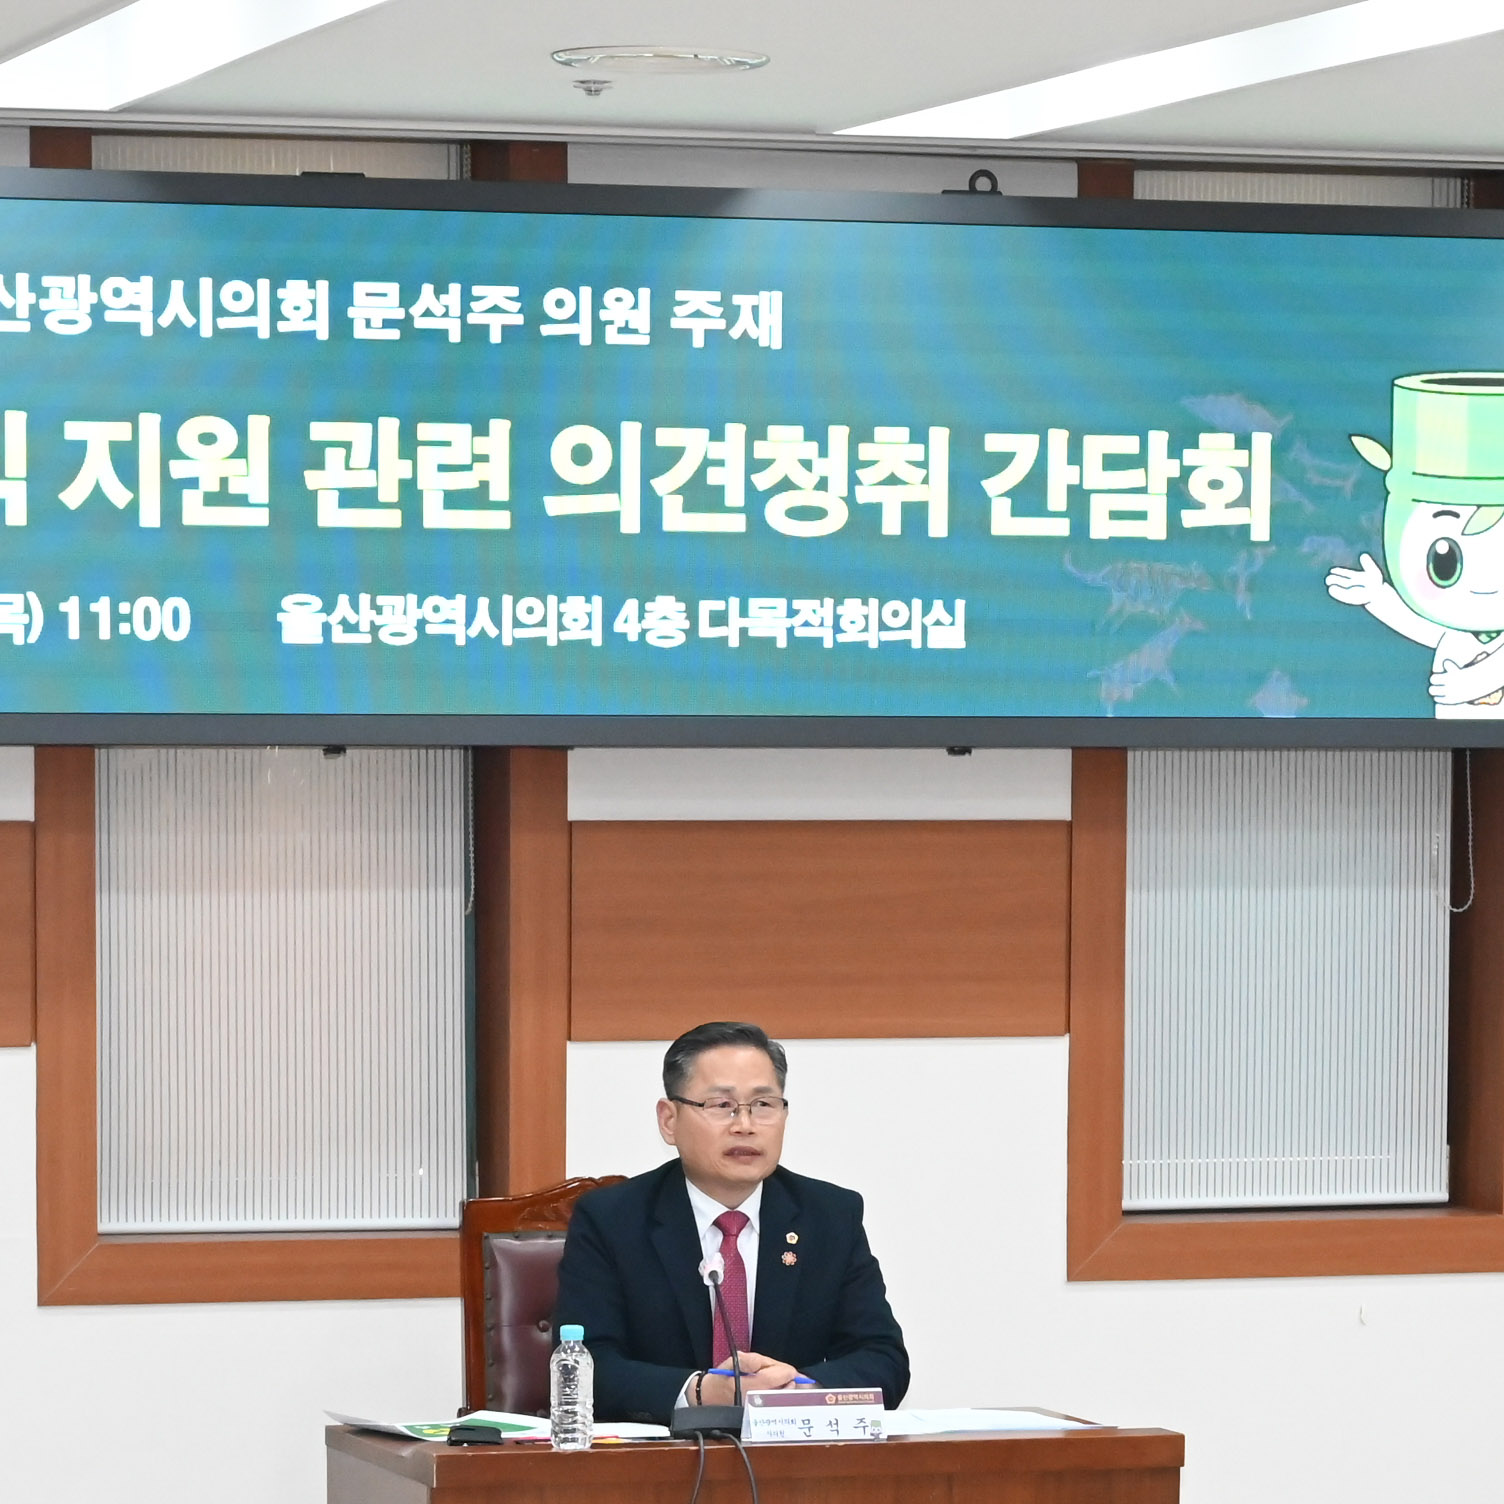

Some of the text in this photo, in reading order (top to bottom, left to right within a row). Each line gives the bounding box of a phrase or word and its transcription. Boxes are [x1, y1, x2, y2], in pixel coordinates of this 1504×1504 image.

[347, 281, 524, 344] 문석주
[539, 285, 651, 346] 의원
[670, 289, 783, 350] 주재
[58, 412, 271, 528] 지원
[303, 416, 512, 530] 관련
[543, 421, 950, 538] 의견청취
[980, 428, 1273, 542] 간담회
[58, 595, 191, 642] 11:00
[276, 592, 966, 649] 울산광역시의회 4층 다목적회의실
